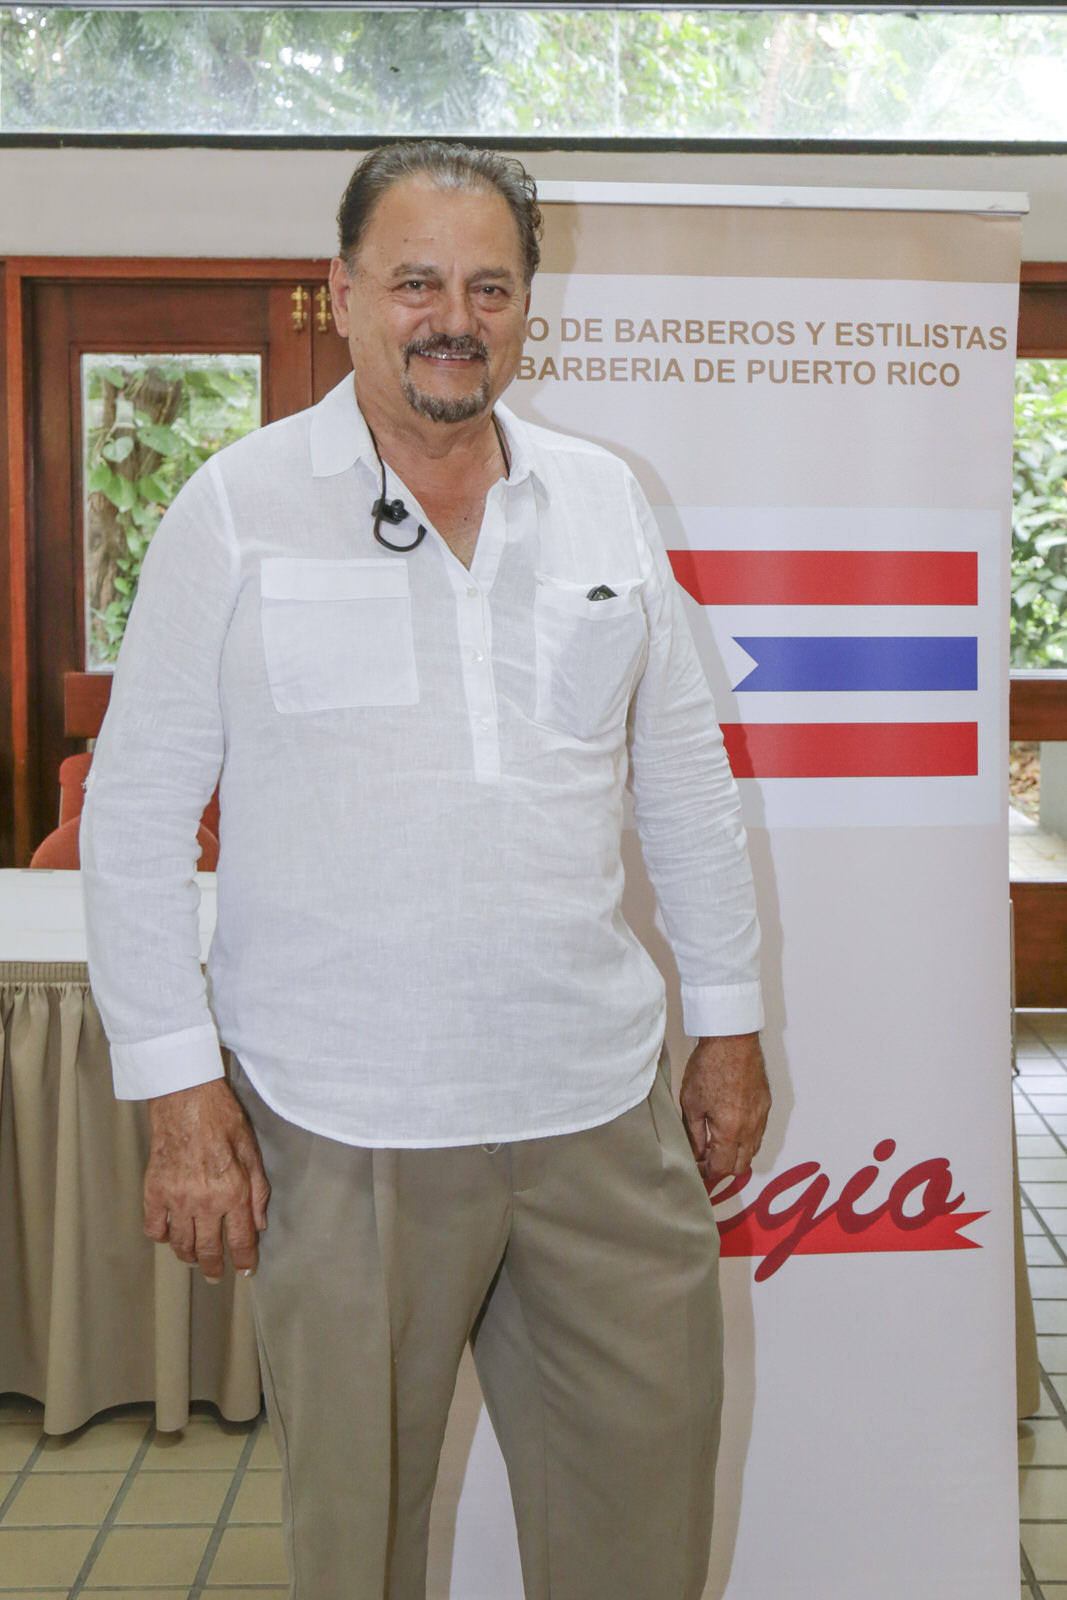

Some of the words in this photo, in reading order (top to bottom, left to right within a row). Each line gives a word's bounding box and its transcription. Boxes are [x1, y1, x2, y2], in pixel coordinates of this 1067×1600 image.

[560, 318, 603, 342] DE
[615, 319, 796, 345] BARBEROS
[805, 321, 825, 346] Y
[835, 322, 1008, 350] ESTILISTAS
[516, 356, 685, 382] BARBERIA
[694, 359, 736, 383] DE
[747, 360, 876, 385] PUERTO
[887, 361, 960, 386] RICO
